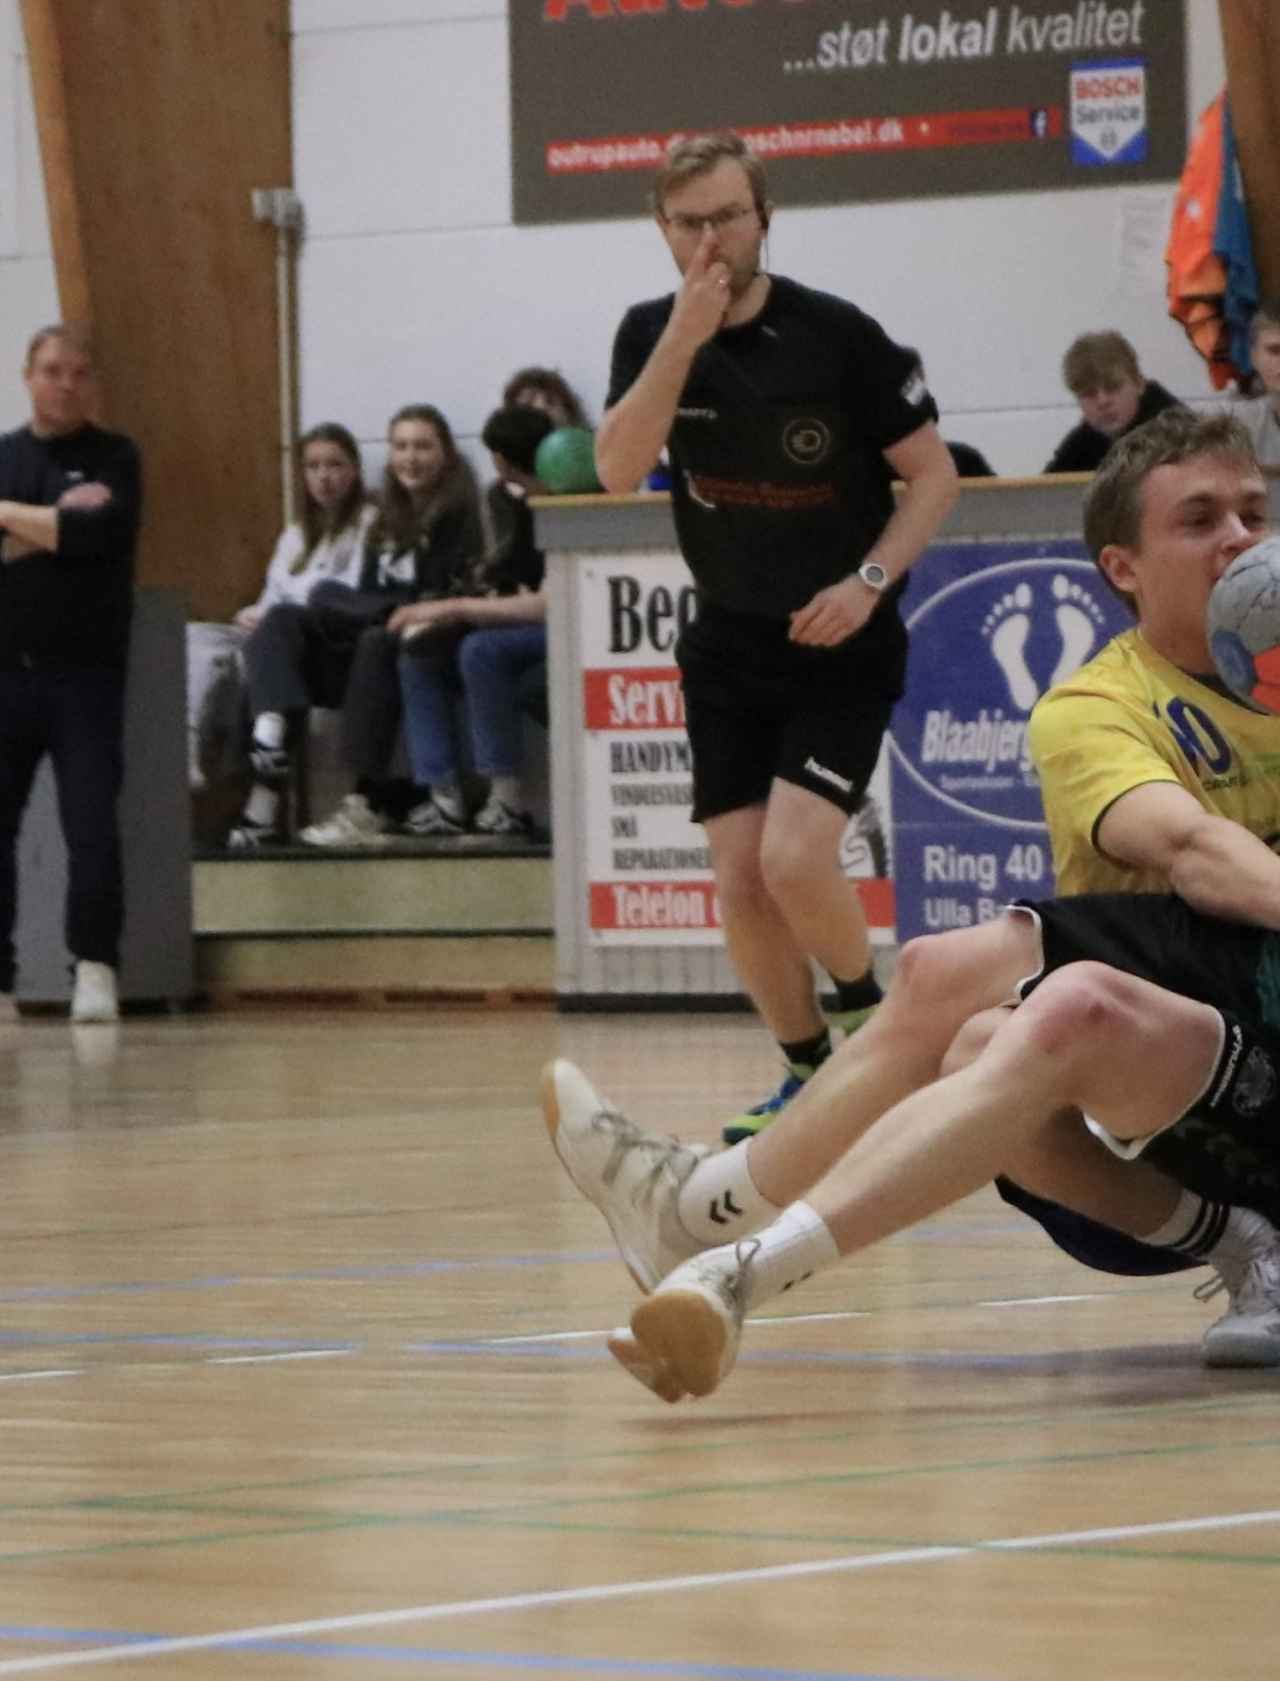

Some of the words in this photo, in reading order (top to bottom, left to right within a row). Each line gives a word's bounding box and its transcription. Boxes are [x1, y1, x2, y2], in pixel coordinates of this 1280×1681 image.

[899, 6, 998, 62] lokal
[1006, 0, 1145, 54] kvalitet
[1075, 76, 1141, 99] BOSCH
[1075, 104, 1142, 125] Service
[924, 844, 998, 892] Ring
[1005, 844, 1043, 881] 40
[613, 884, 705, 926] Telefon
[926, 898, 972, 927] Ulla
